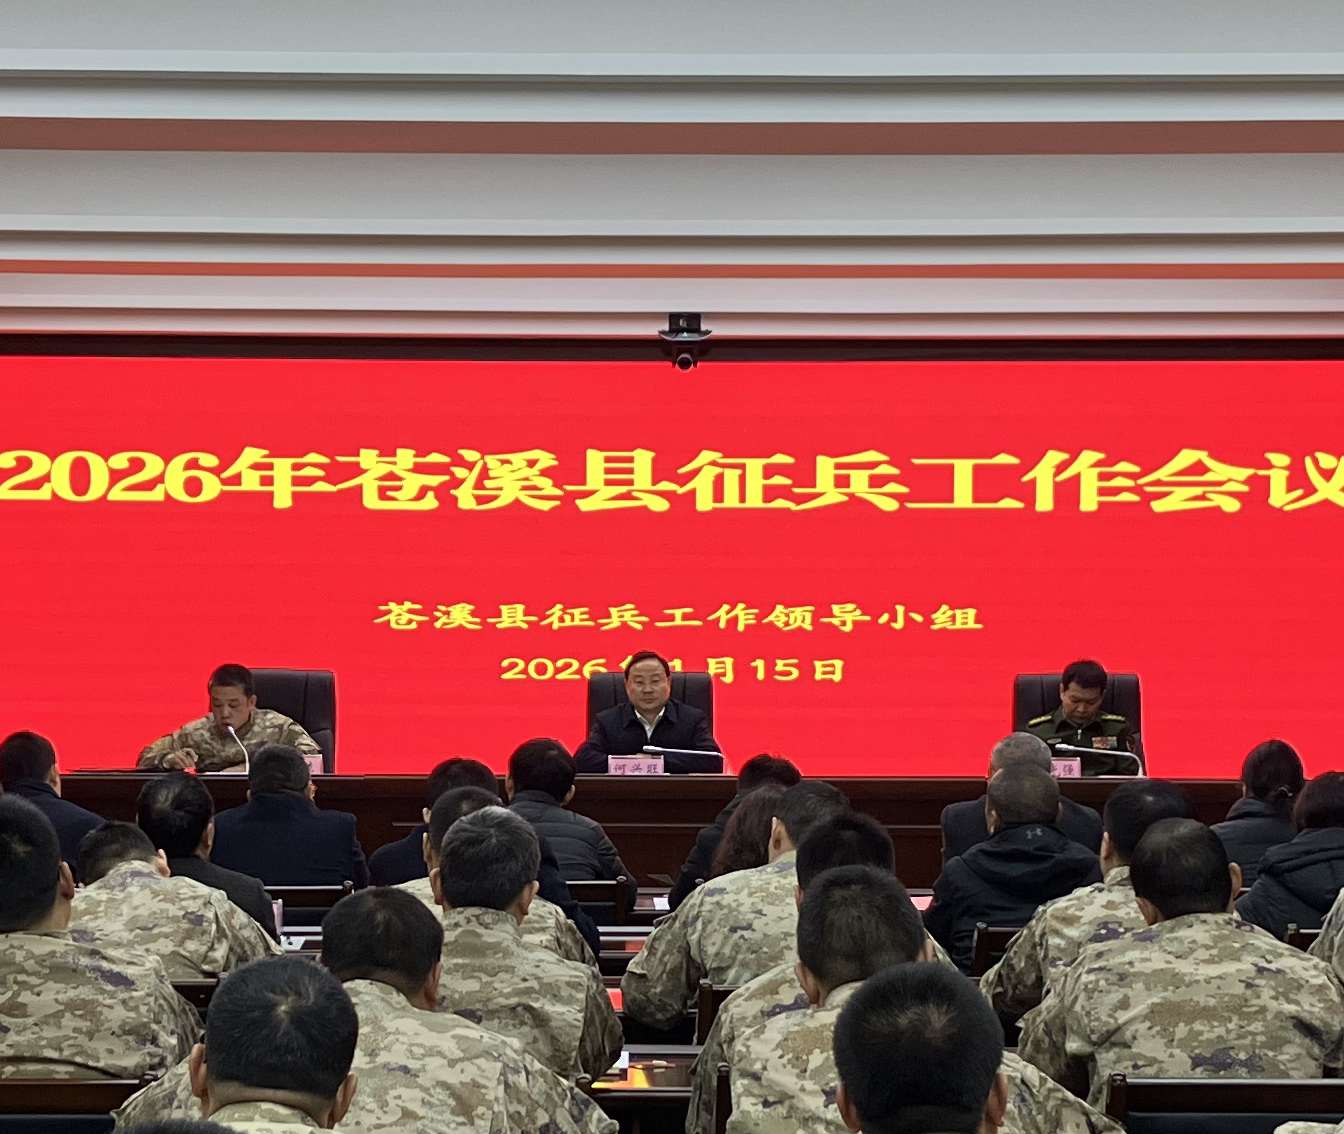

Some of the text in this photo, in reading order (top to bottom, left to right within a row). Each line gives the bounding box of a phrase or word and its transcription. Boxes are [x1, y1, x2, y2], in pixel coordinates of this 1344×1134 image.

[373, 600, 984, 633] 苍溪县征兵工作领导小组
[500, 656, 845, 684] 20261月15日
